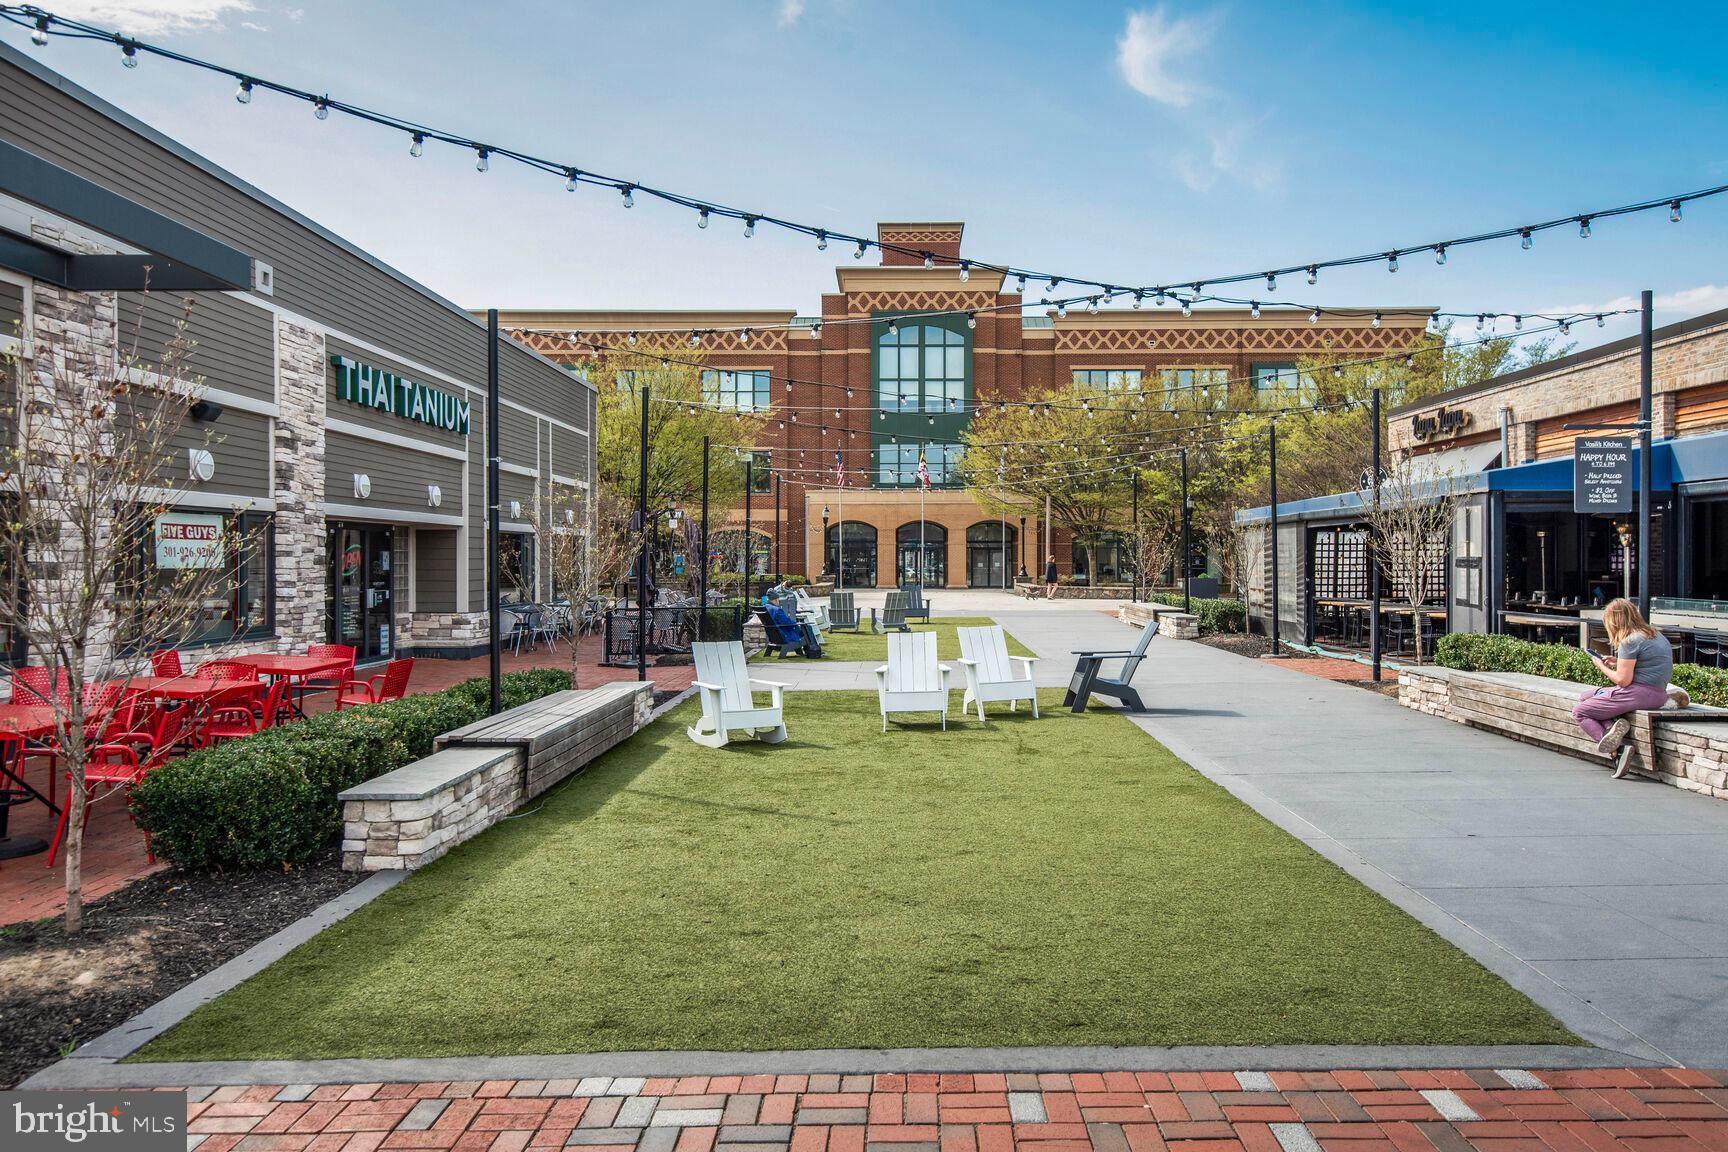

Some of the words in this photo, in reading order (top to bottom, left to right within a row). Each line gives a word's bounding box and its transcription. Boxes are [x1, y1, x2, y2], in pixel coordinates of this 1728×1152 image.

[331, 355, 395, 413] THAI
[396, 377, 471, 436] TANIUM
[1580, 453, 1604, 461] HAPPY
[1605, 453, 1627, 461] HOUR
[161, 525, 184, 538] FIVE
[186, 526, 216, 540] GUYS
